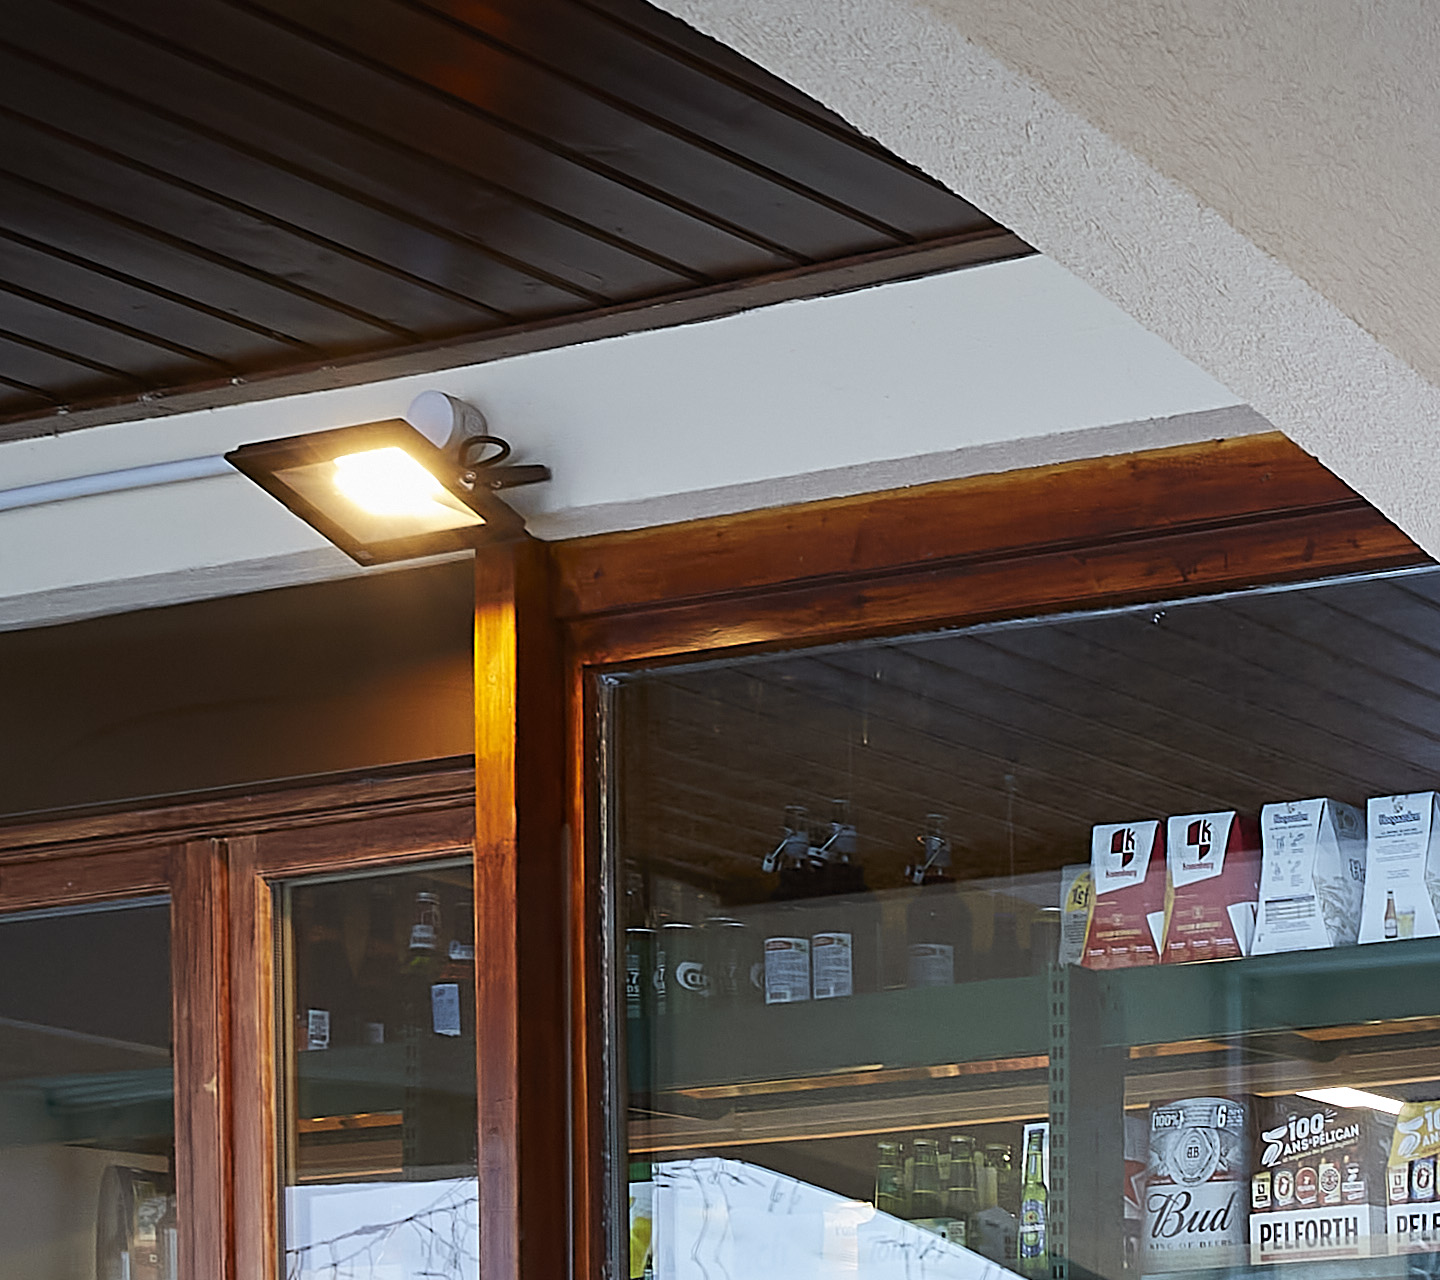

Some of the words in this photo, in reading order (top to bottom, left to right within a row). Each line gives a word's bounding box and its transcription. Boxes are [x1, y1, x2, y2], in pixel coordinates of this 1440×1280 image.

[1288, 1113, 1324, 1140] 100
[1147, 1190, 1239, 1239] Bud
[1259, 1216, 1359, 1251] PELFORTH
